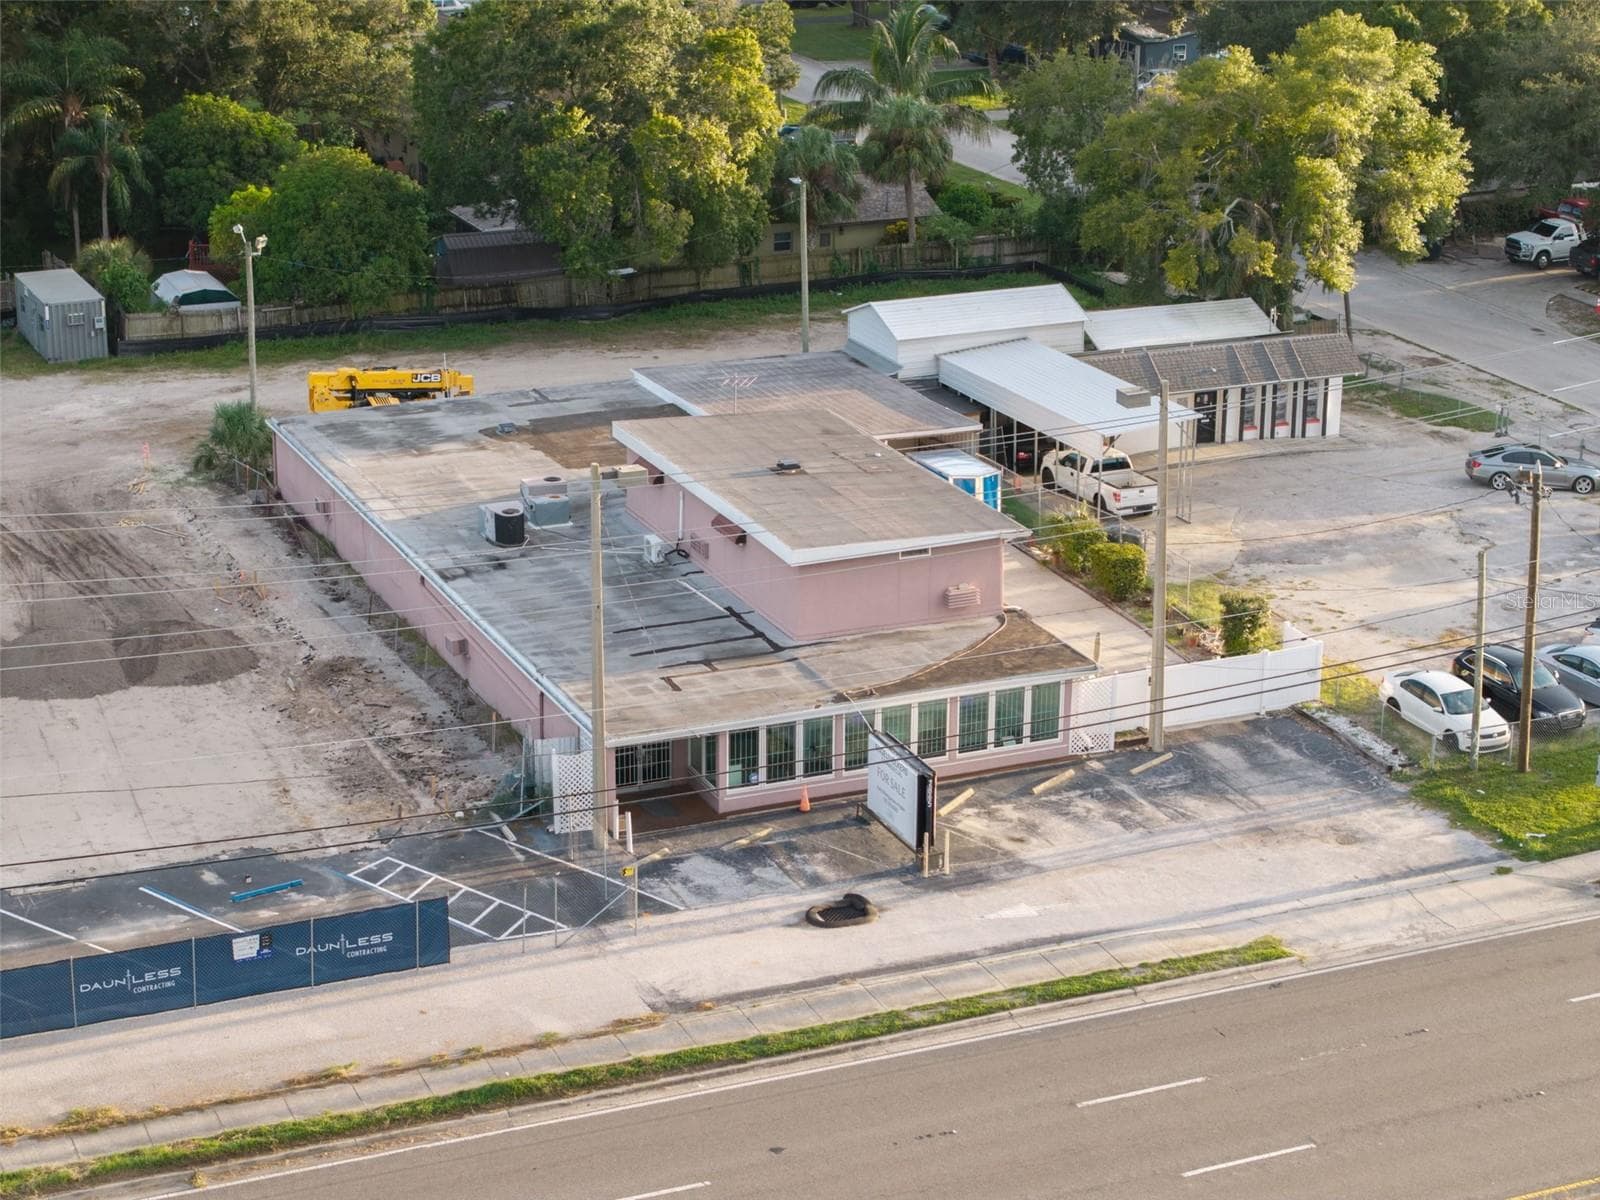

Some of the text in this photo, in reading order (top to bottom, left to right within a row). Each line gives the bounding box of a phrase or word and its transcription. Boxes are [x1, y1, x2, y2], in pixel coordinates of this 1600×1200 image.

[412, 373, 441, 383] JCB
[877, 766, 890, 786] FOR
[890, 777, 906, 799] SALE
[295, 932, 394, 956] DAUNTLESS
[346, 945, 388, 959] CONTRACTING
[79, 966, 182, 993] DAUNTLESS
[133, 979, 176, 994] CONTRACTING
